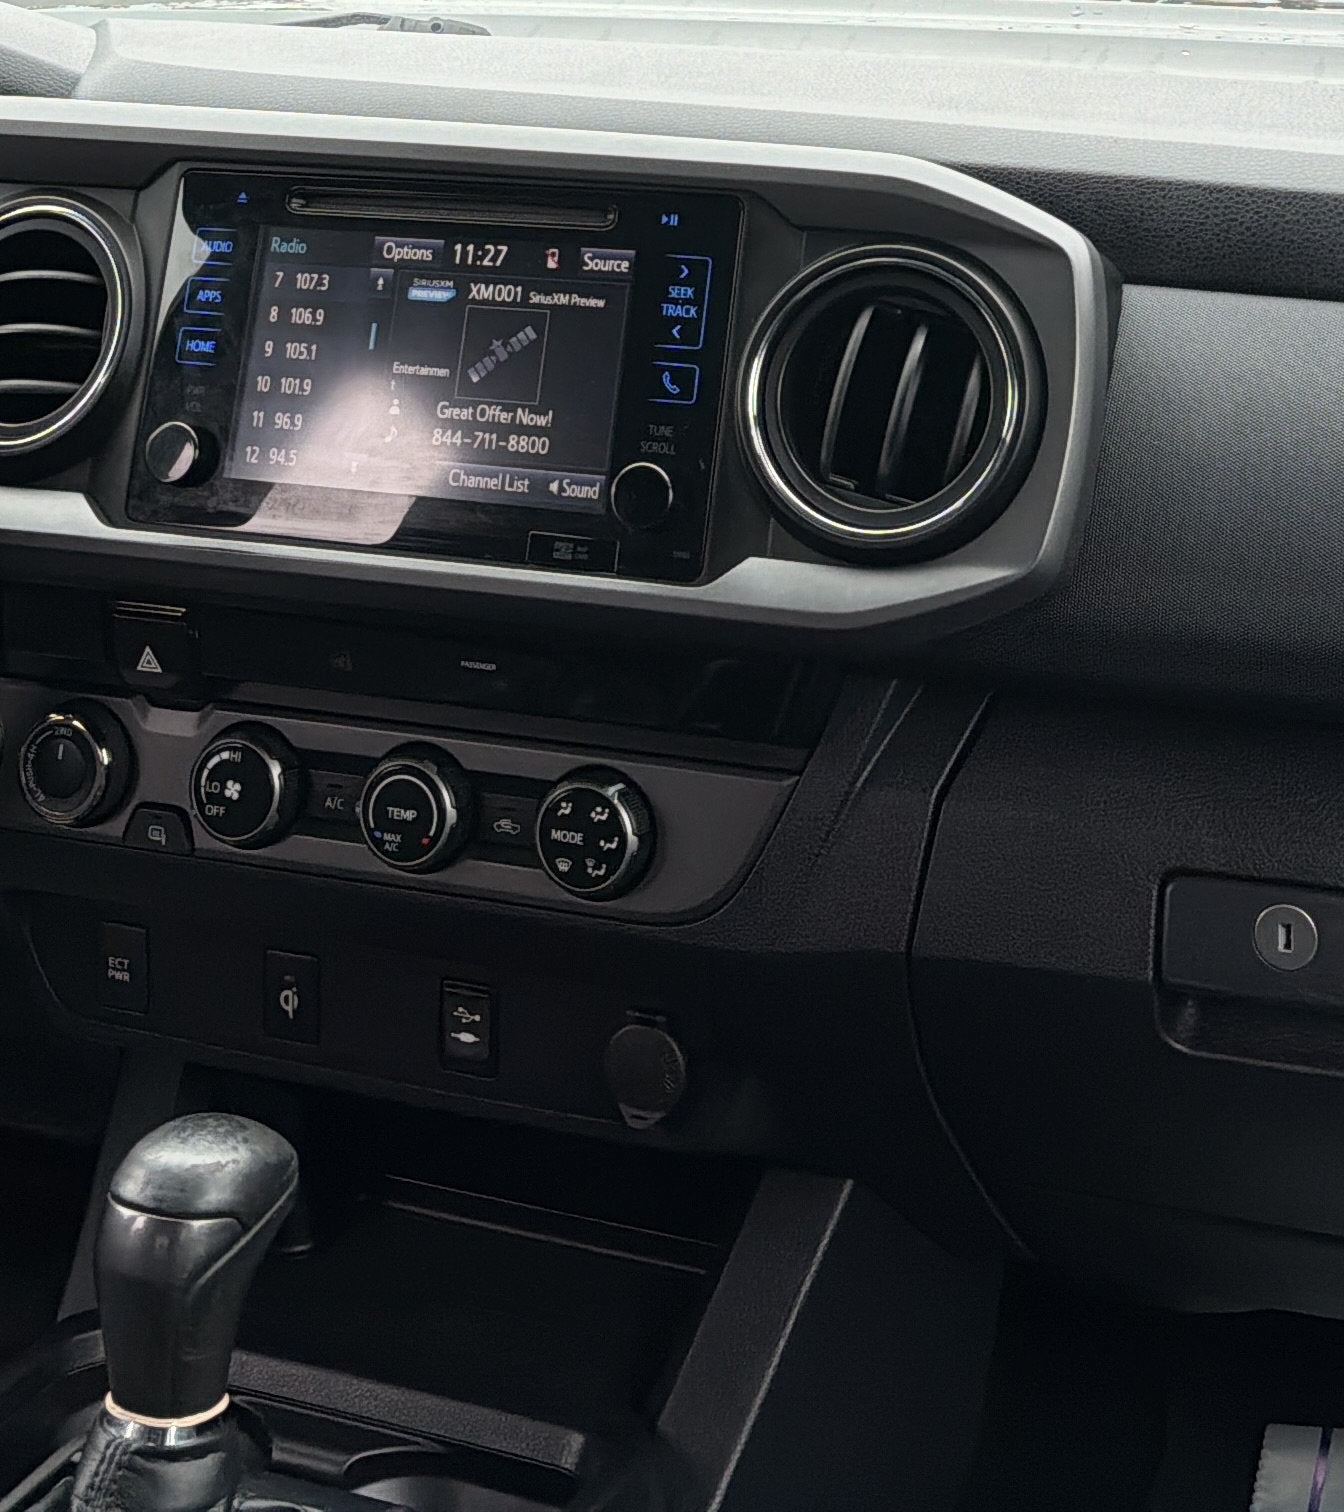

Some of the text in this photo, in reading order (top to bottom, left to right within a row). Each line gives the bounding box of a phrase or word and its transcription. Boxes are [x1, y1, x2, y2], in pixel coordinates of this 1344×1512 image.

[199, 239, 234, 253] AUDIO
[270, 236, 307, 254] Radio
[383, 241, 433, 263] Options
[454, 243, 509, 267] 11:27
[582, 252, 631, 273] Source
[274, 271, 330, 292] 7 107.3
[196, 289, 222, 303] APPS
[528, 291, 606, 309] SiriusXM Preview
[668, 286, 695, 300] SEEK
[269, 305, 325, 326] 8 106.9
[661, 304, 698, 319] TRACK
[185, 339, 216, 354] HOME
[264, 340, 317, 361] 9 105.1
[392, 362, 450, 377] Entertainmen
[256, 375, 312, 396] 10 101.9
[252, 410, 303, 431] 11 96.9
[436, 401, 553, 428] Great Offer Now!
[648, 424, 674, 438] TUNE
[432, 428, 550, 455] 844-711-8800
[640, 440, 676, 456] SCROLL
[245, 445, 298, 467] 12 94.5
[448, 468, 530, 493] Channel List
[561, 478, 600, 500] Sound
[229, 750, 242, 763] HI
[206, 781, 221, 793] LO
[205, 804, 226, 817] OFF
[324, 796, 345, 810] A/C
[387, 806, 418, 821] TEMP
[383, 832, 403, 843] MAX
[550, 828, 584, 845] MODE
[384, 842, 399, 852] A/C
[108, 956, 130, 970] ECT
[107, 968, 130, 983] PWR
